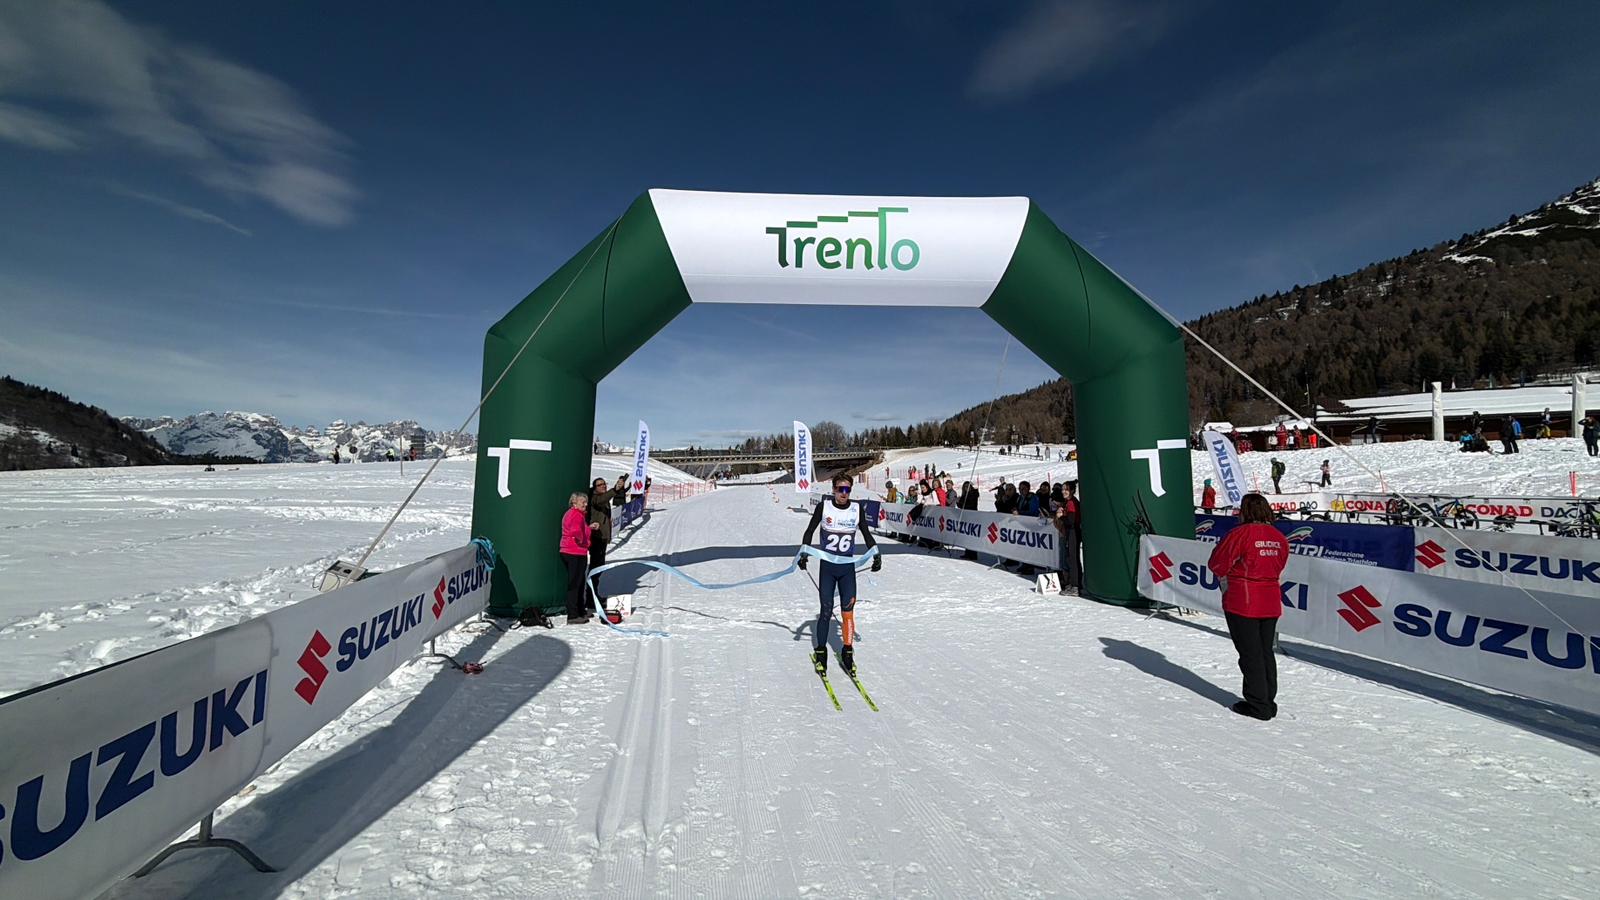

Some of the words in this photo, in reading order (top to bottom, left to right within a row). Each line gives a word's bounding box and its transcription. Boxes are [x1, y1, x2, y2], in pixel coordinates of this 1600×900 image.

[886, 513, 904, 522] SUZUKI
[946, 518, 982, 537] SUZUKI
[826, 534, 852, 552] 26
[1000, 527, 1053, 550] SUZUKI
[1325, 549, 1364, 558] Federazione
[1179, 562, 1308, 611] SUKI
[336, 593, 425, 672] SUZUKI
[0, 669, 268, 867] UZUKI
